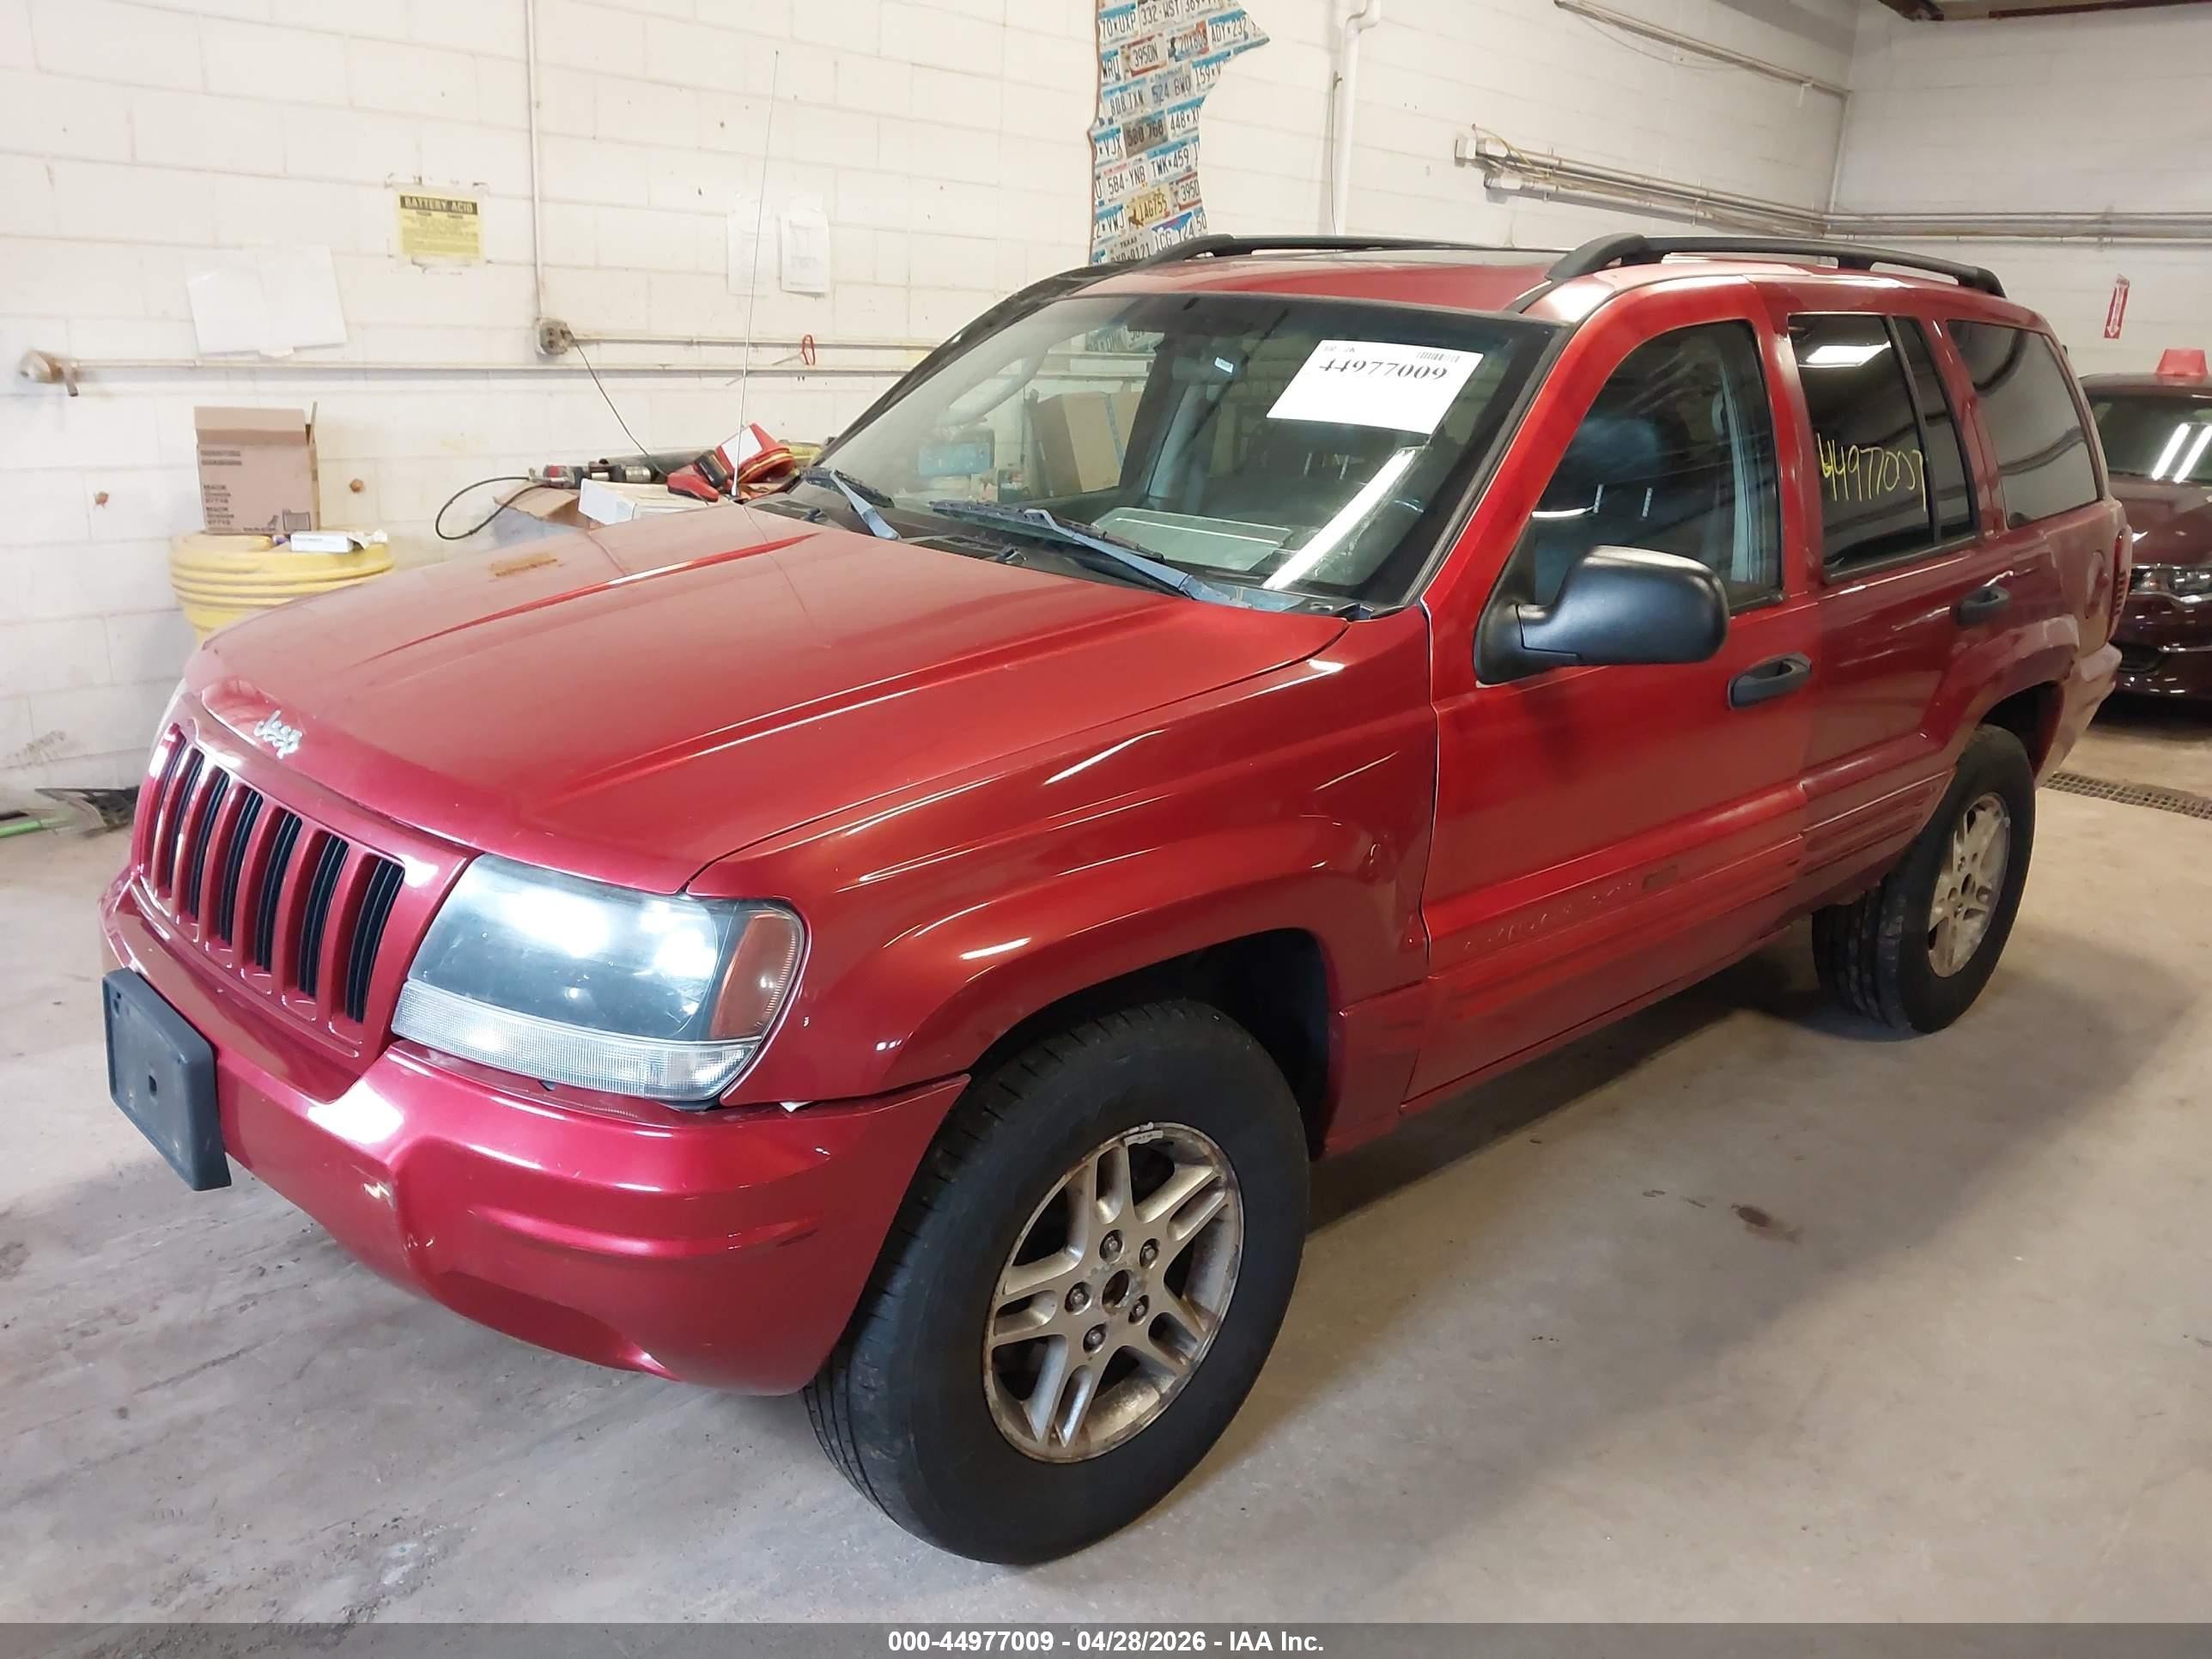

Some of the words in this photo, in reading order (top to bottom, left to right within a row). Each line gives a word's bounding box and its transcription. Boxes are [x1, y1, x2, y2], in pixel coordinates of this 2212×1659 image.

[404, 196, 449, 212] BATTERY
[451, 201, 475, 215] ACID
[1318, 357, 1448, 380] 44977009
[253, 708, 303, 760] Jeep
